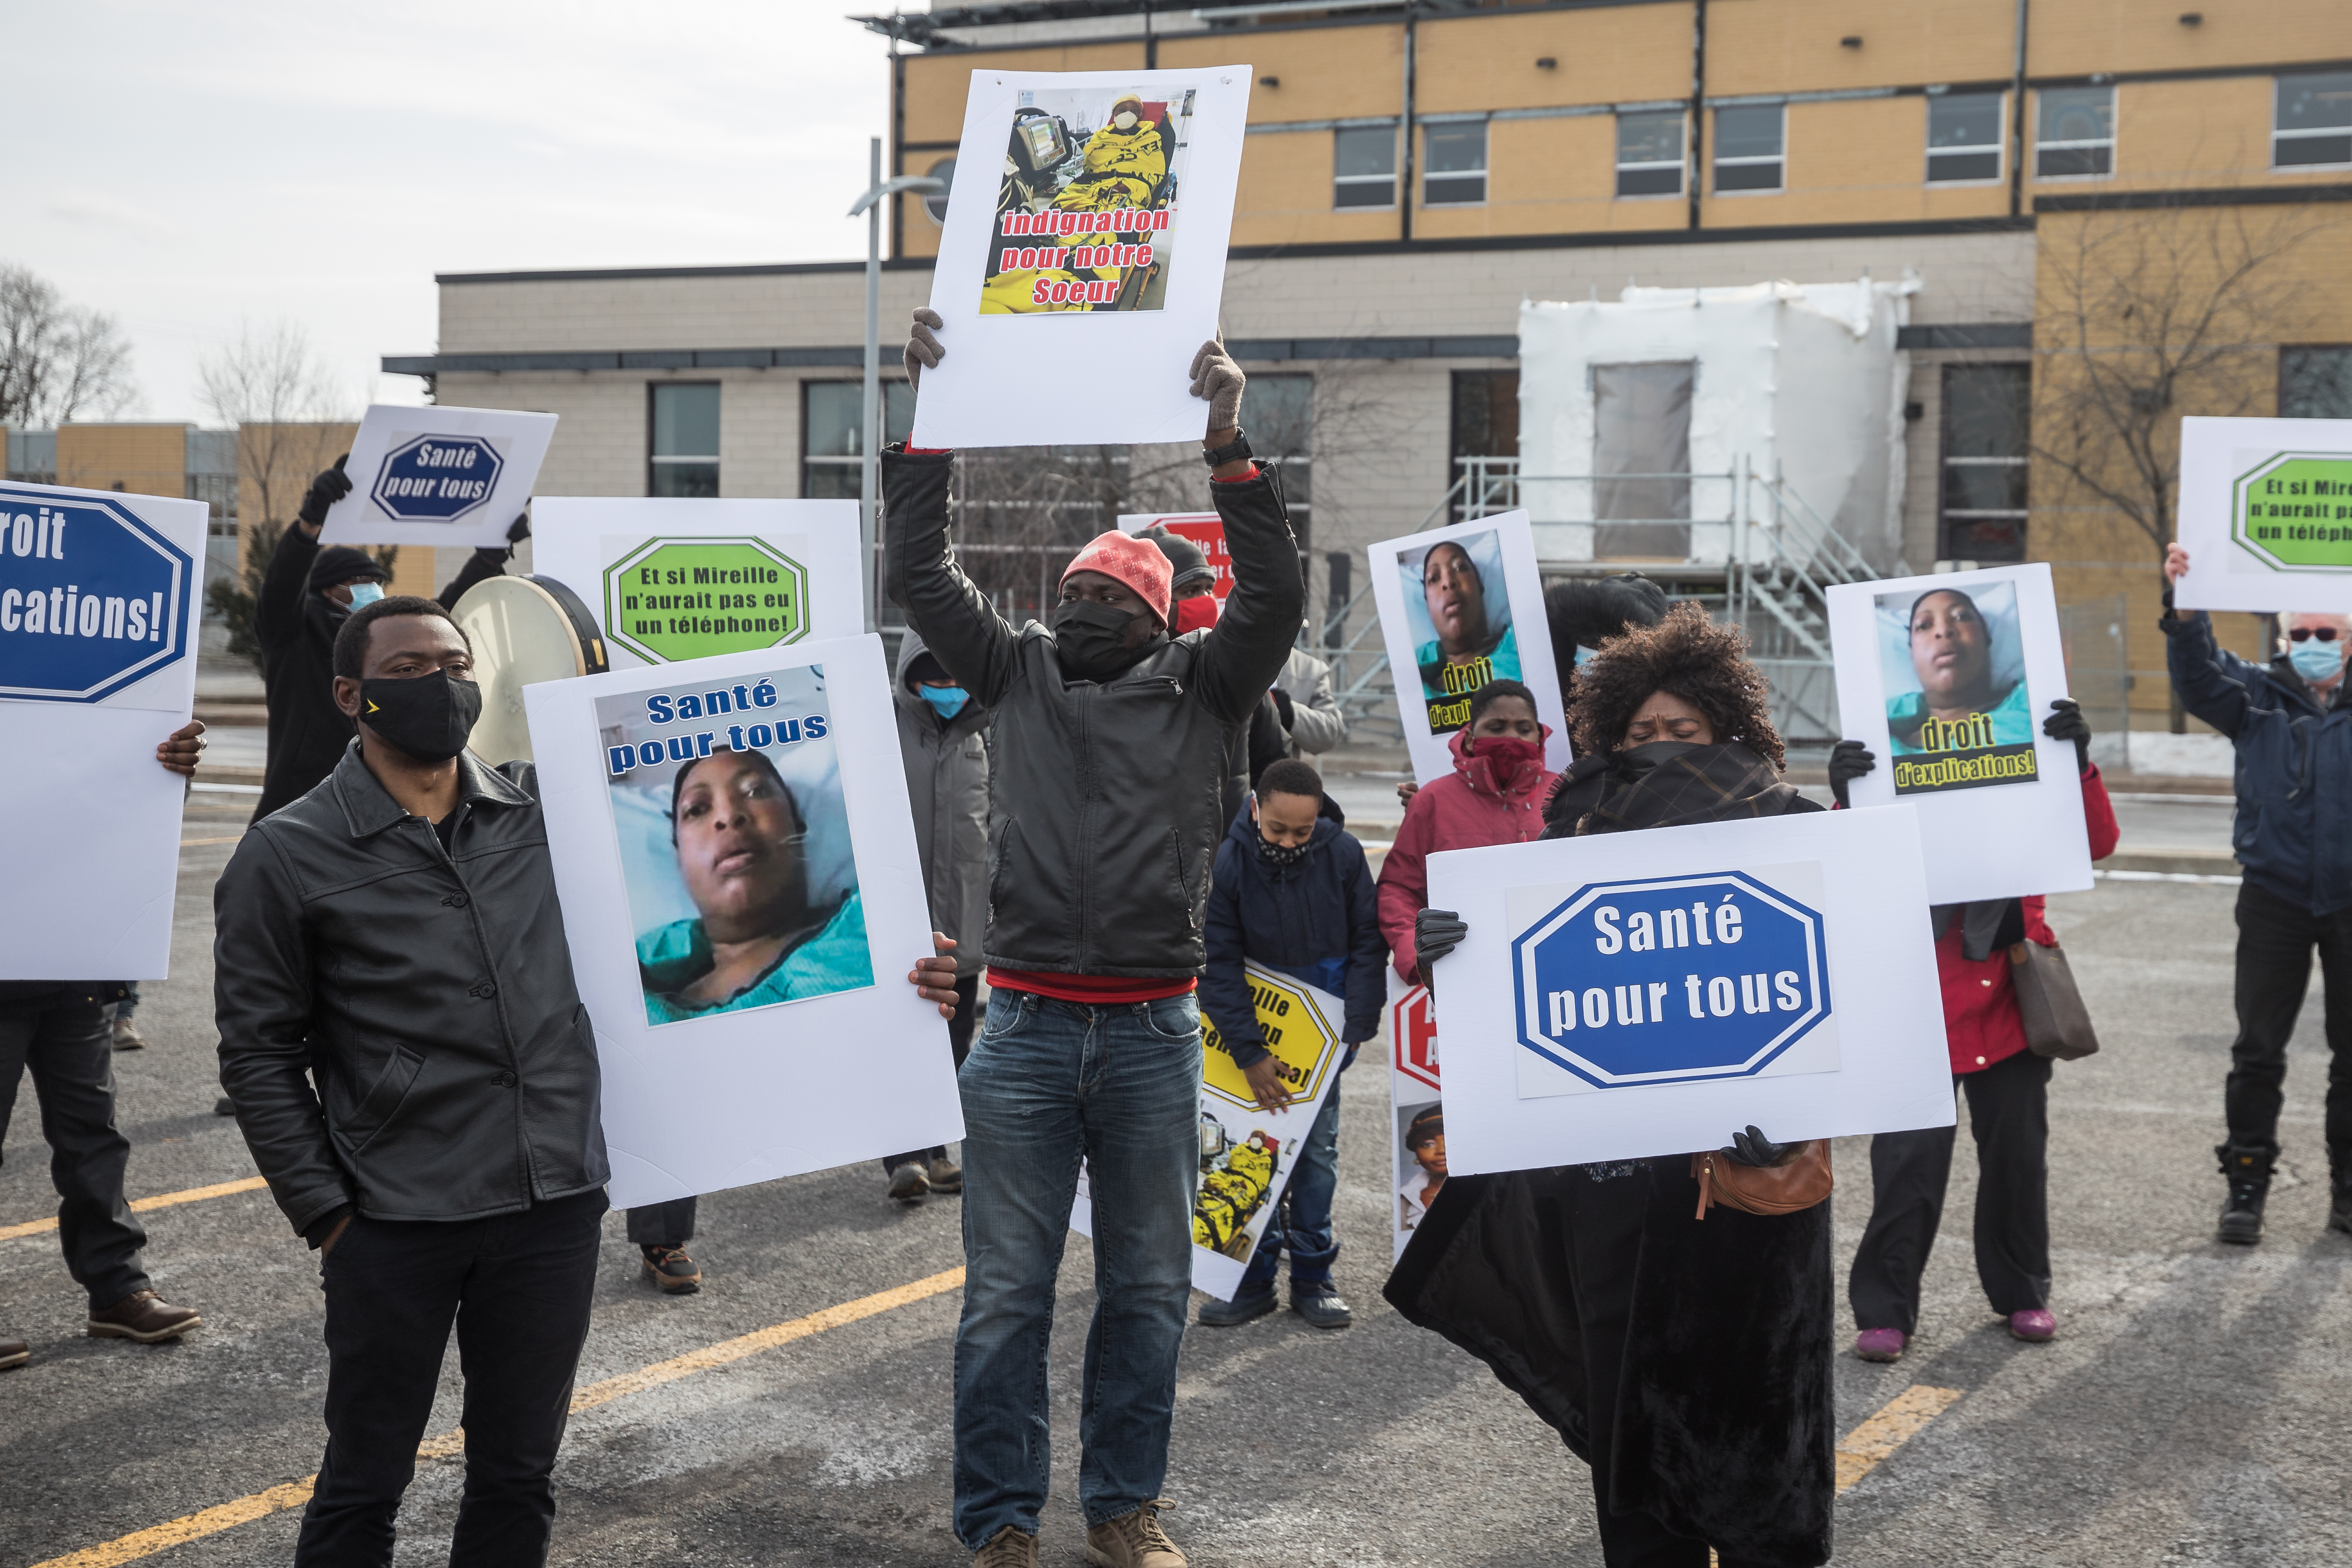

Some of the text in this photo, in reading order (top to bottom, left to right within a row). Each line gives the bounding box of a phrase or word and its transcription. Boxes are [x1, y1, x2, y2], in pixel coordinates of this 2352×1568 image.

[1001, 206, 1170, 237] indignation
[999, 242, 1154, 273] pour notre
[1033, 277, 1119, 305] Soeur
[416, 443, 478, 468] Santé
[384, 477, 485, 499] pour tous
[2267, 478, 2283, 494] Et
[2290, 479, 2307, 495] si
[2251, 501, 2329, 517] n'aurait
[2258, 525, 2281, 539] un
[641, 566, 778, 585] Et si Mireille
[719, 593, 757, 610] pas
[765, 593, 789, 608] eu
[636, 615, 787, 635] un téléphone!
[1443, 657, 1494, 695] droit
[646, 676, 779, 726] Santé
[607, 714, 829, 775] pour tous
[1921, 713, 1995, 753] droit
[1894, 749, 2036, 787] d'explications!
[1594, 894, 1743, 955] Santé
[1548, 970, 1802, 1037] pour tous
